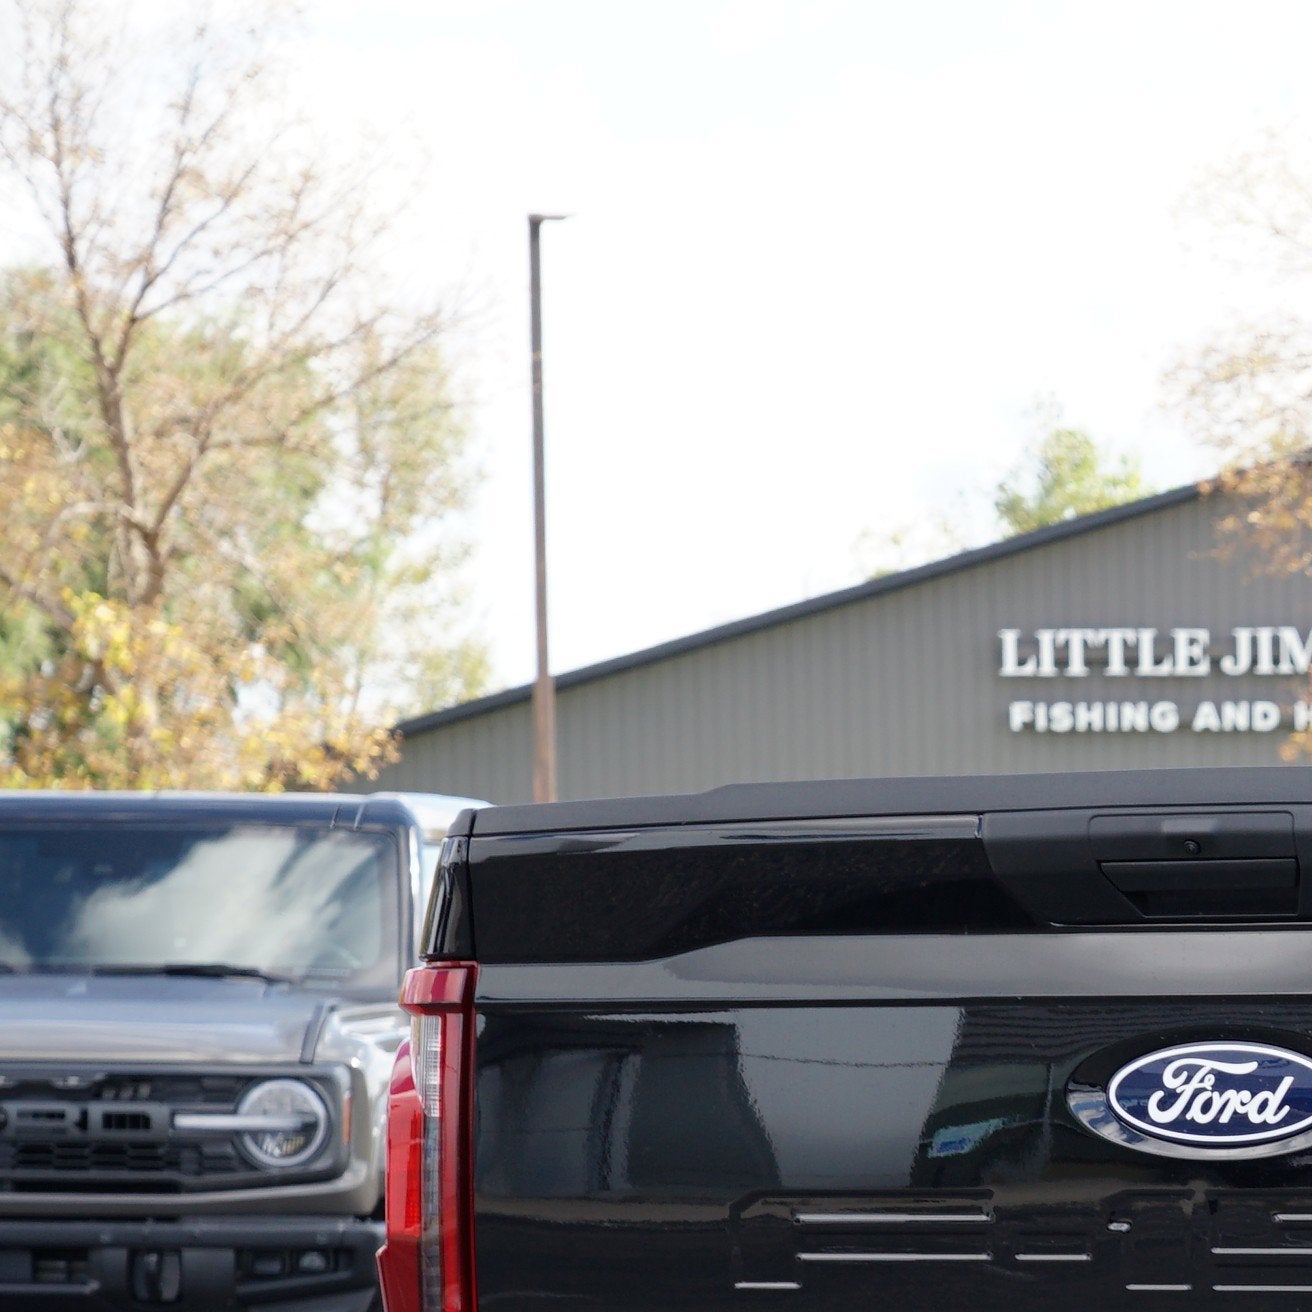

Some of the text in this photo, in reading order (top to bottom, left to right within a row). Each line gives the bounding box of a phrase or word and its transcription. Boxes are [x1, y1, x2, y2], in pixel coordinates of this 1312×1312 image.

[998, 627, 1210, 677] LITTLE
[1009, 700, 1179, 732] FISHING
[1192, 700, 1280, 732] AND
[1147, 1057, 1294, 1124] Ford
